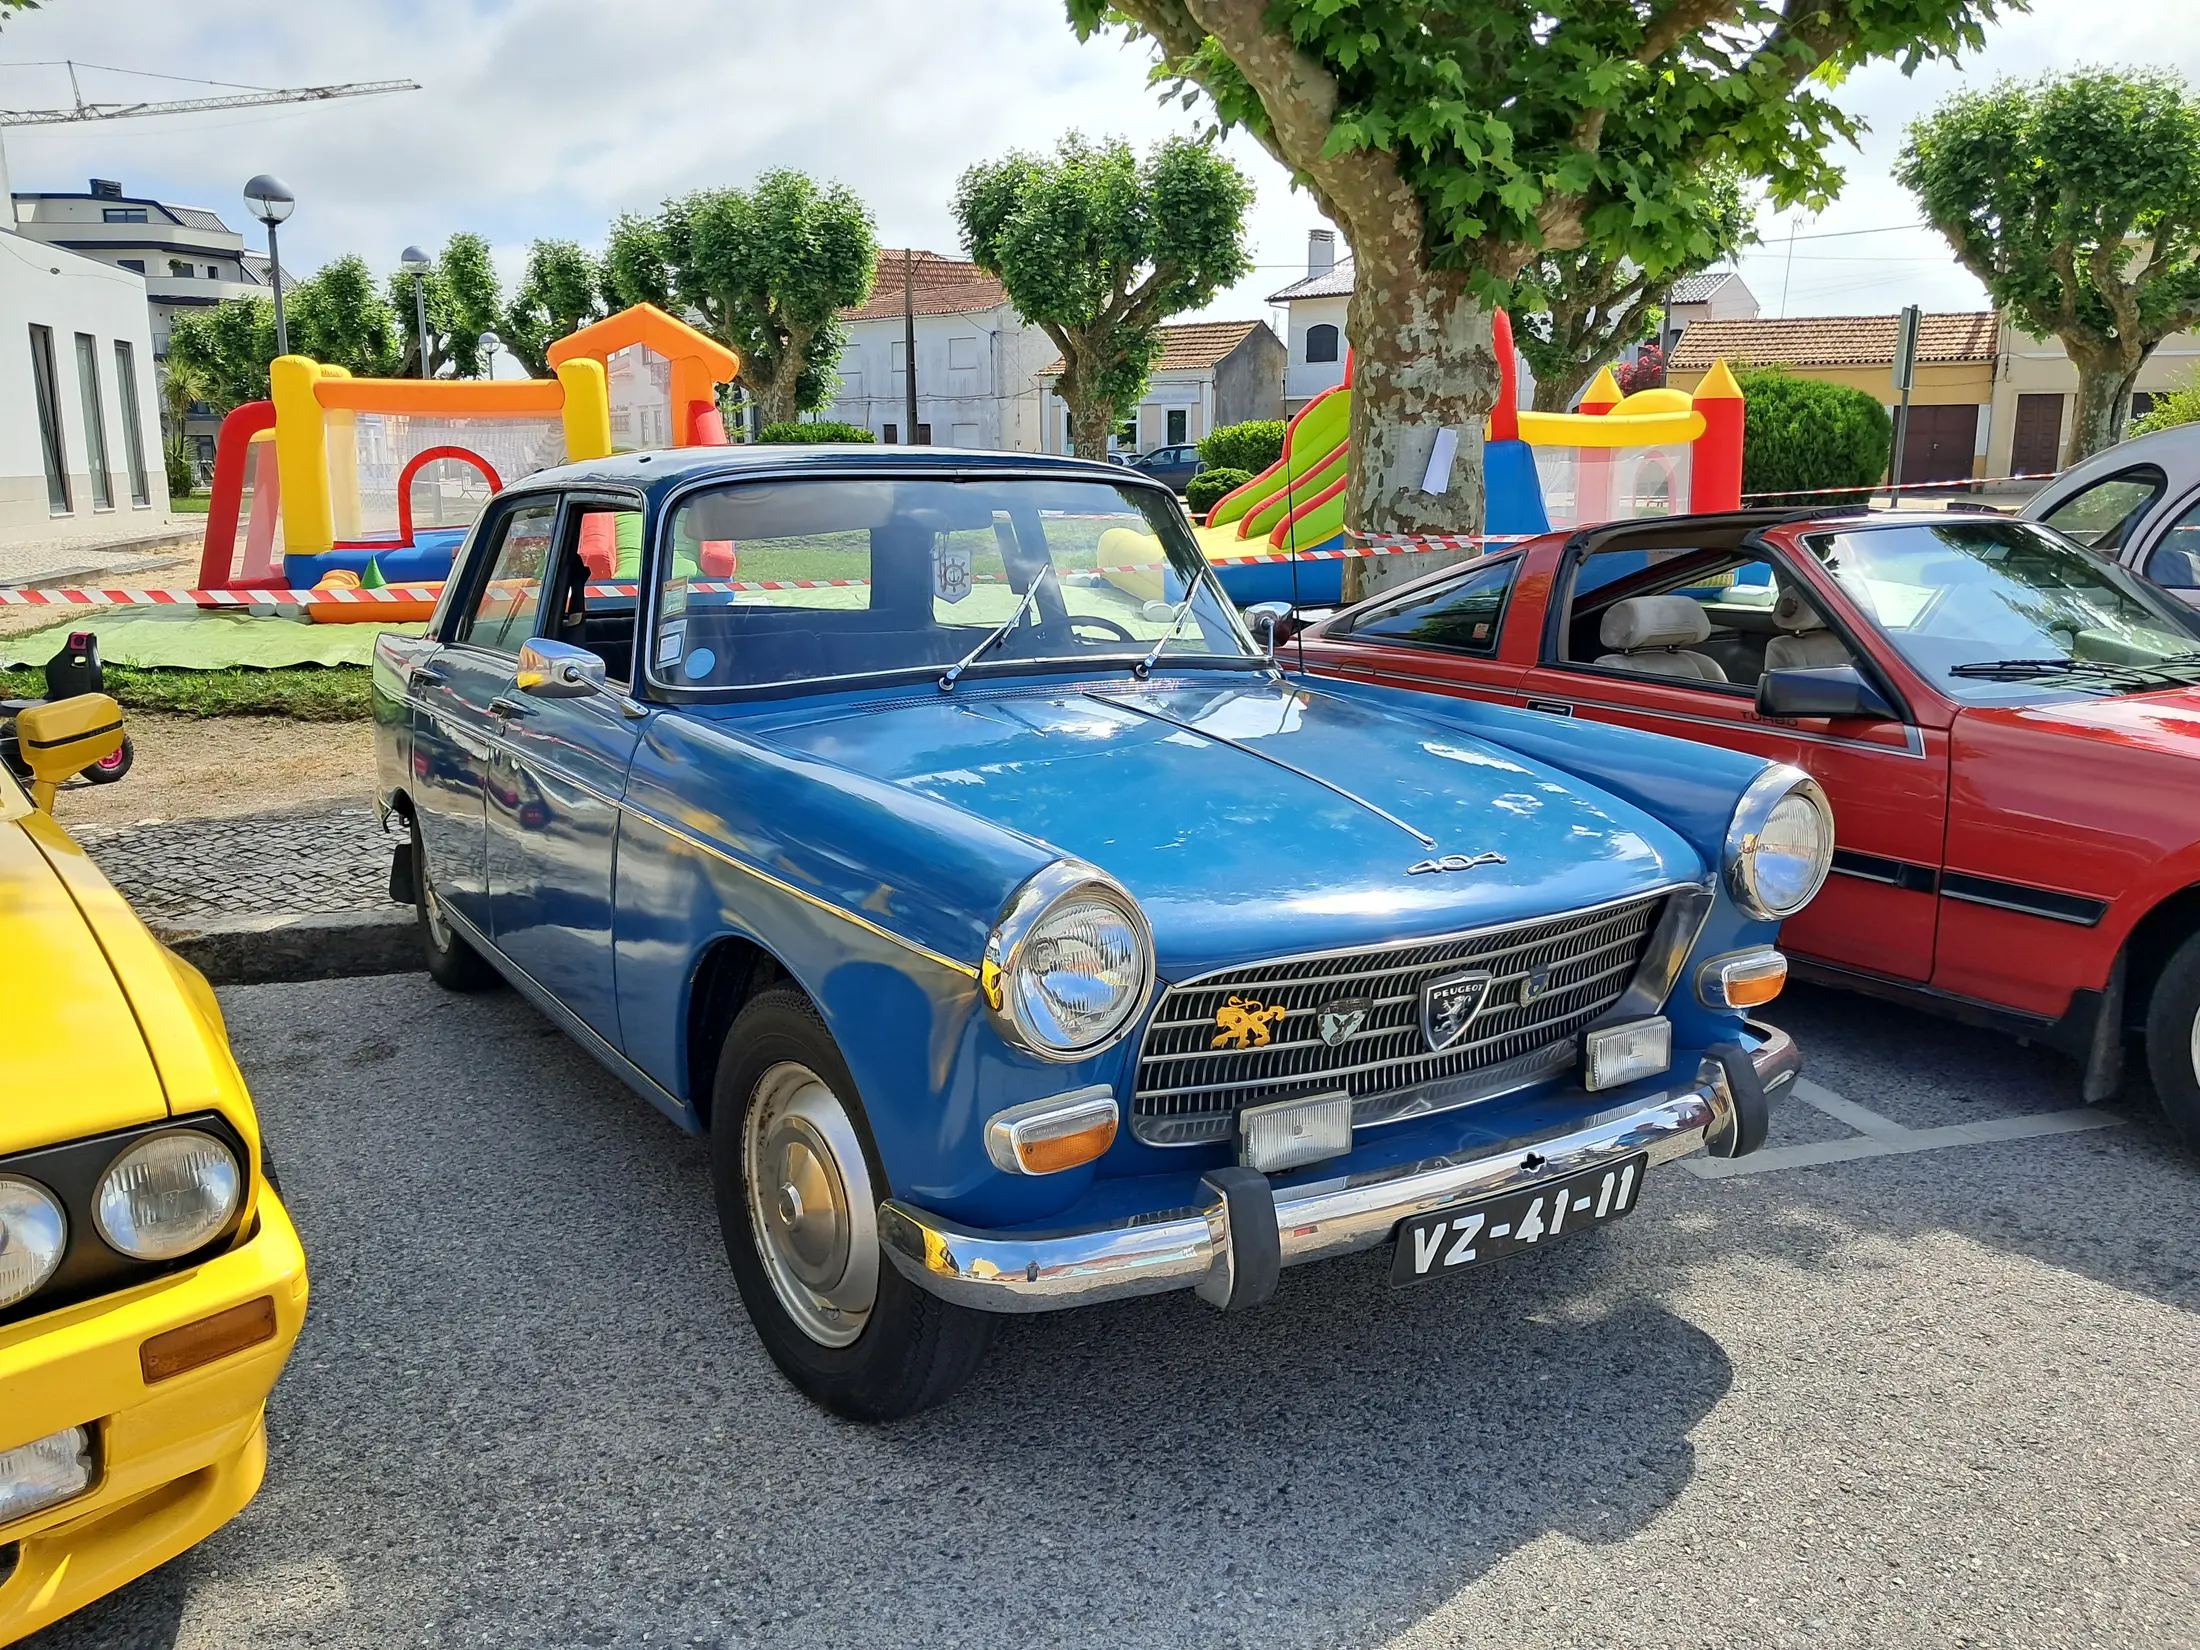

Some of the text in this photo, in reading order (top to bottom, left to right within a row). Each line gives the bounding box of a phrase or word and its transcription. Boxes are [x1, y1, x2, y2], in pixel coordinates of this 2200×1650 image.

[1407, 851, 1507, 875] 404
[1433, 984, 1484, 1000] PEUGEOT
[1413, 1164, 1635, 1274] VZ-41-11
